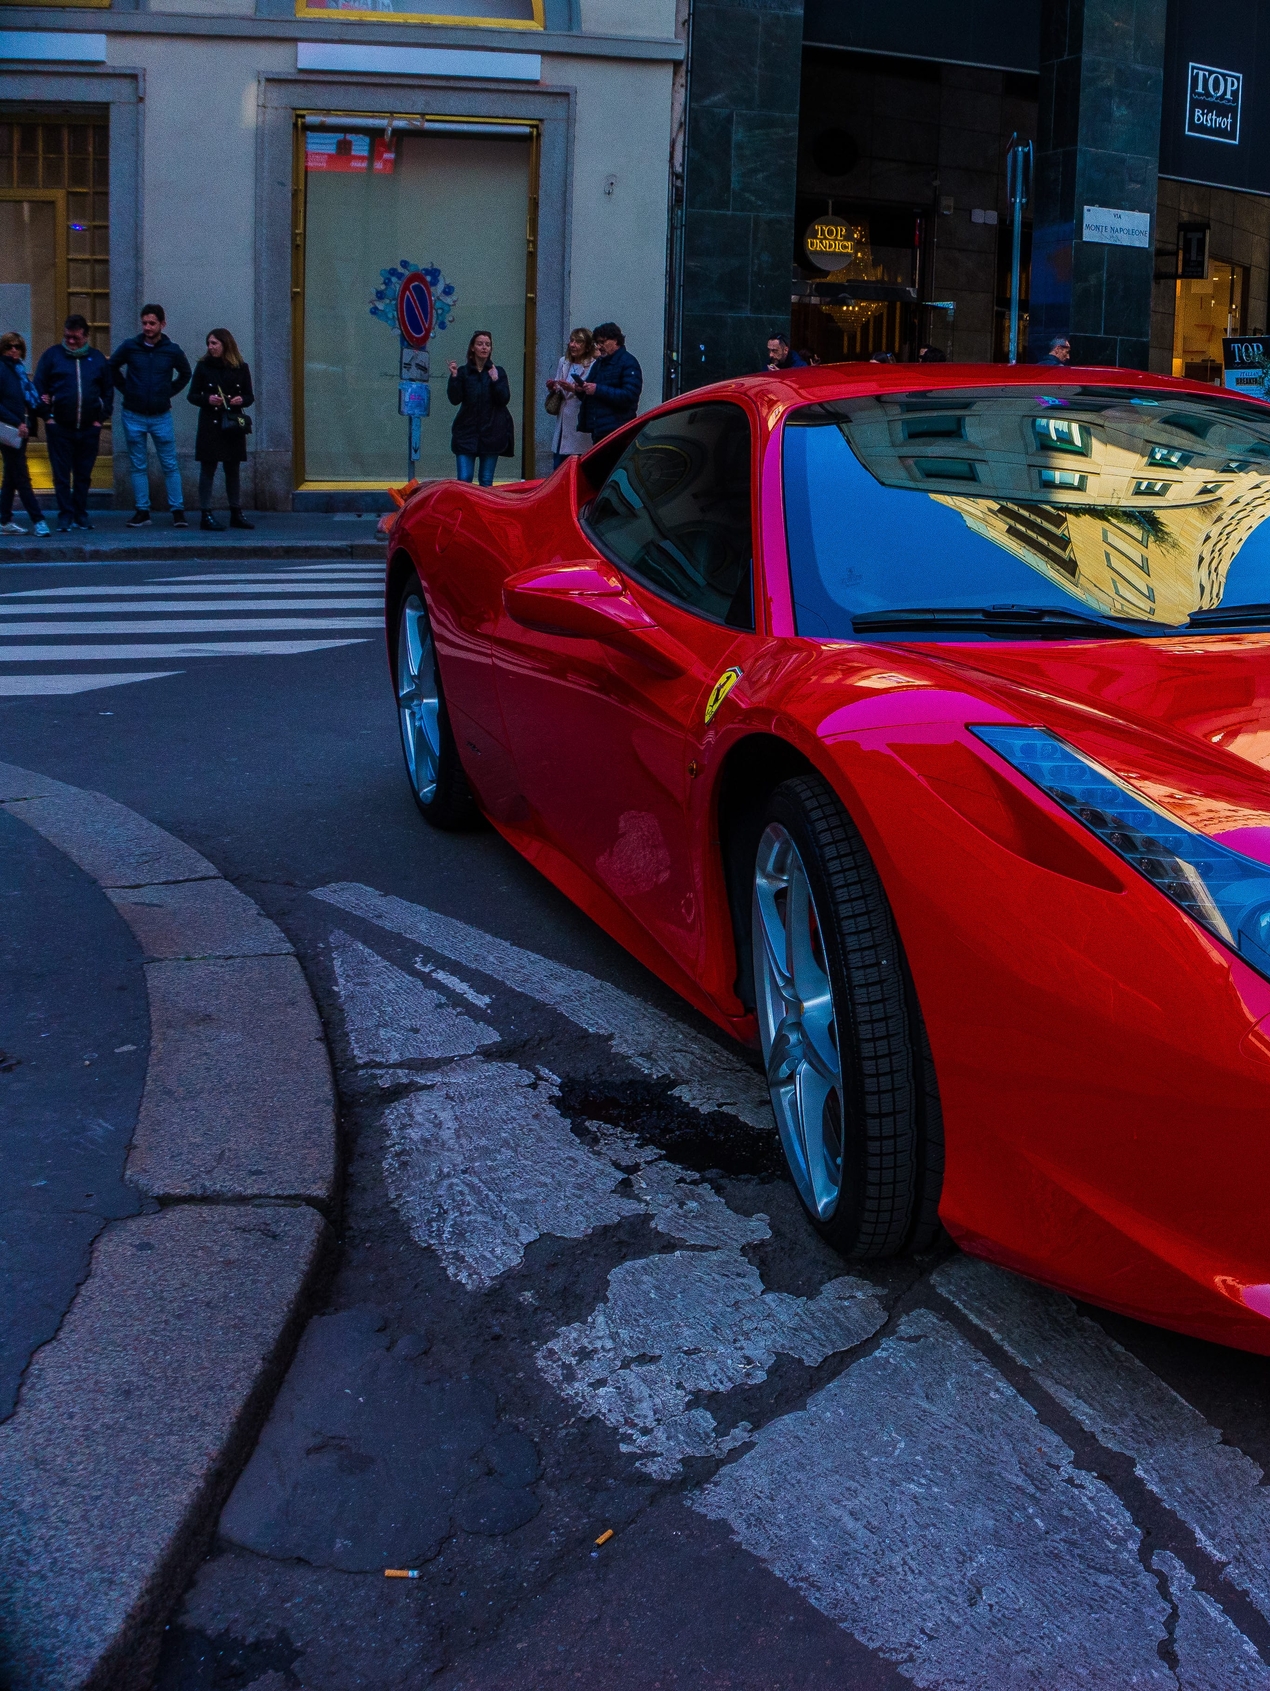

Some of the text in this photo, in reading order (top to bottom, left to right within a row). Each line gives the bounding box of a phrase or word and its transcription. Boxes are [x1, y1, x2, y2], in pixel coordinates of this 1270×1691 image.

[1193, 69, 1238, 100] TOP
[1194, 108, 1232, 132] Bistrot
[815, 225, 847, 239] TOP
[1084, 224, 1148, 237] MONTE NAPOLEONE
[808, 238, 854, 252] UNDICI
[1231, 343, 1263, 362] TOP
